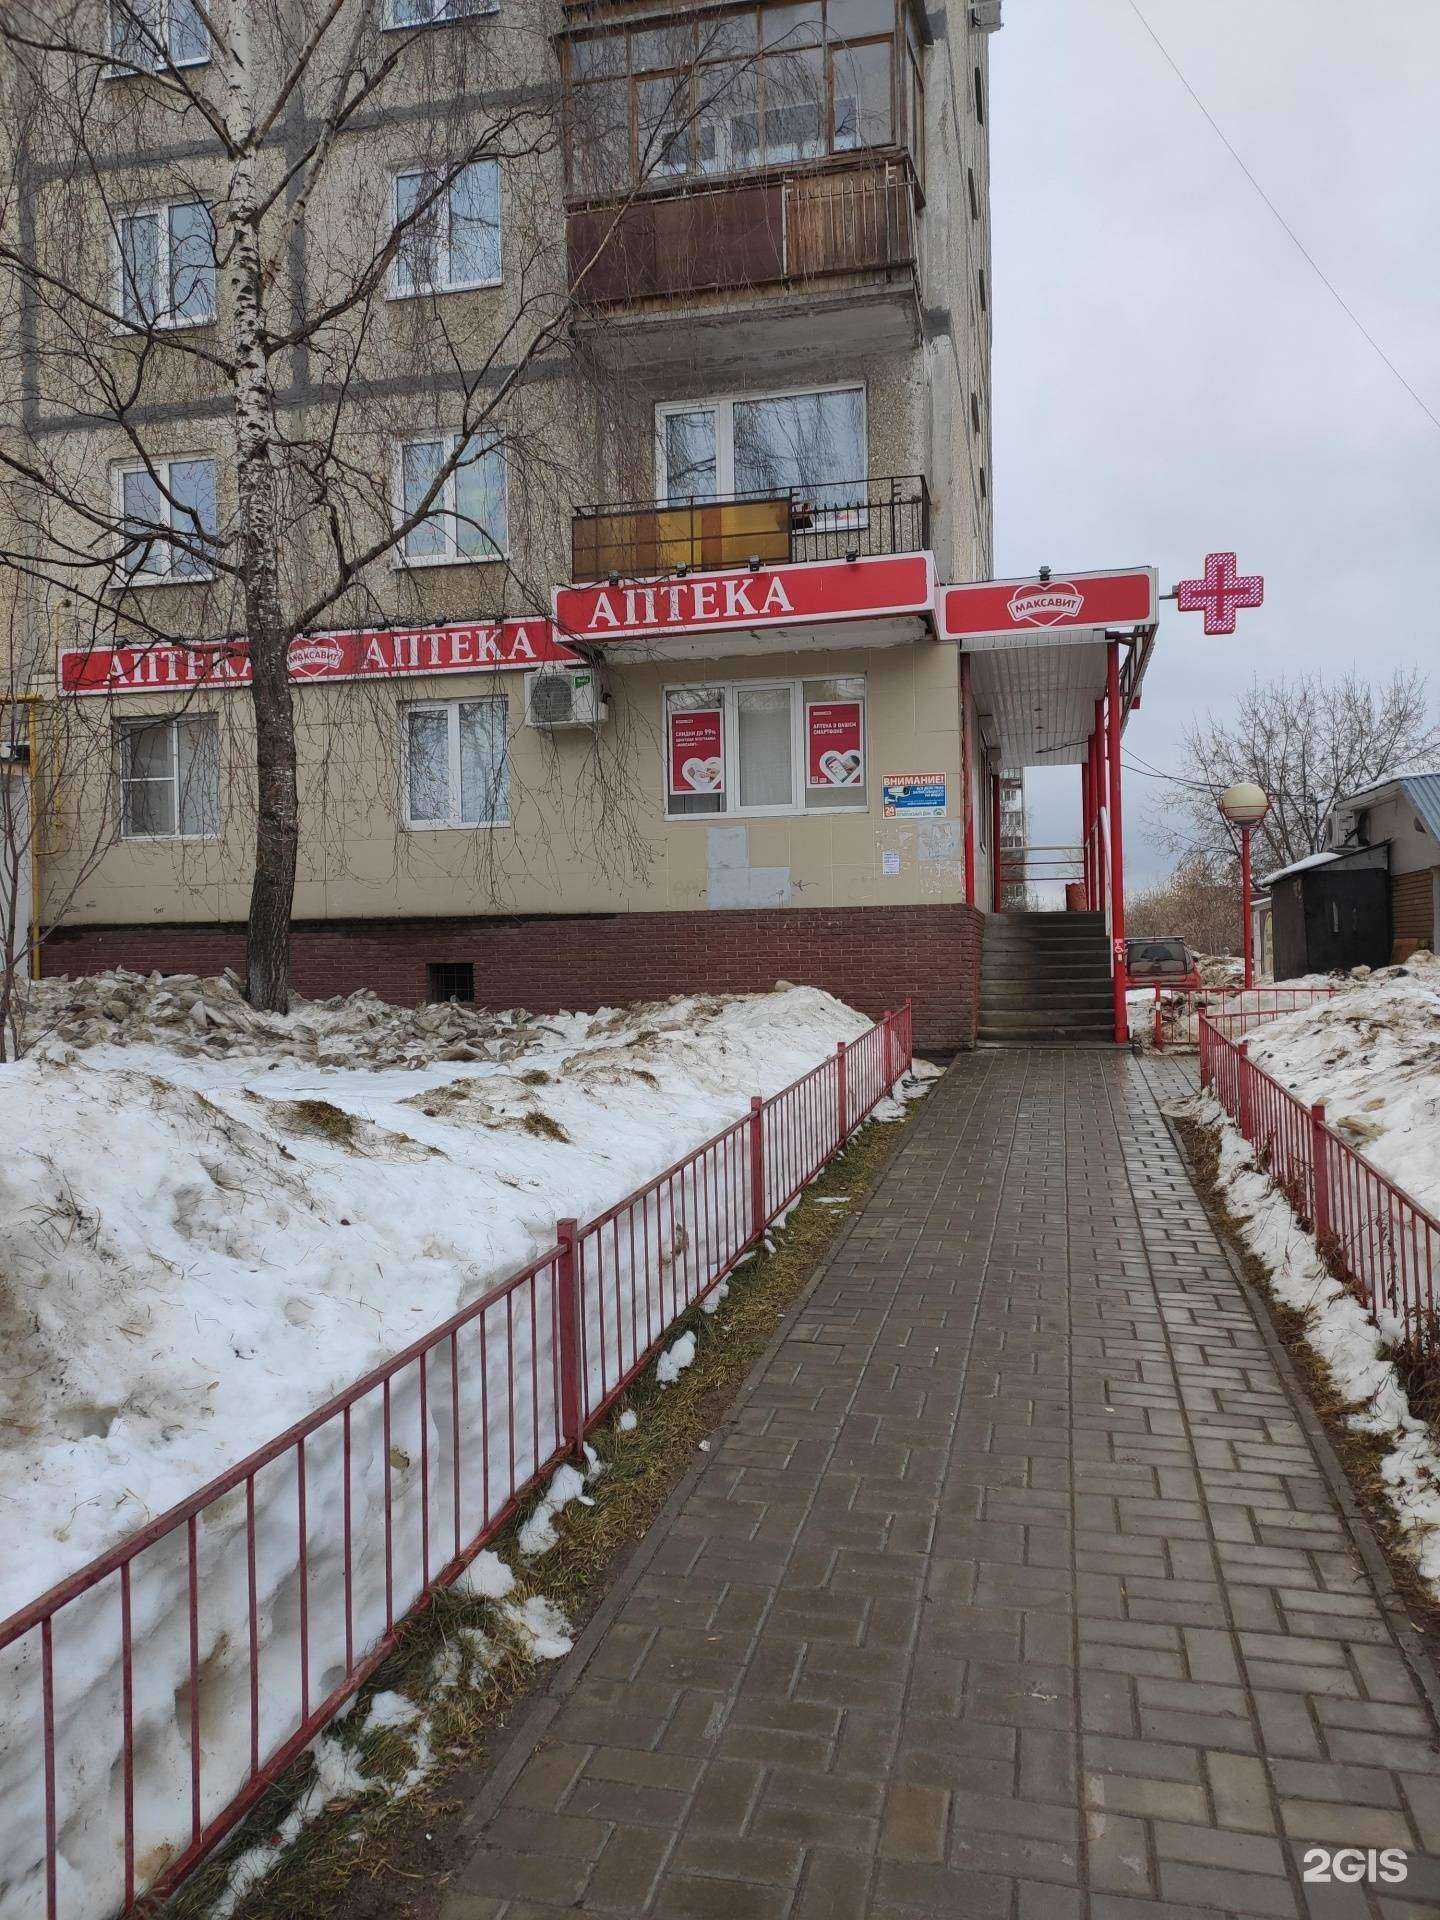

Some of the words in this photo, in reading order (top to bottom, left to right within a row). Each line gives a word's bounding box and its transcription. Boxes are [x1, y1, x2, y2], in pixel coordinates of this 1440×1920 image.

[587, 576, 795, 628] АПТЕКА
[1015, 598, 1077, 613] МАКСАВИТ
[360, 627, 537, 669] АПТЕКА
[883, 775, 945, 786] ВНИМАНИЕ!
